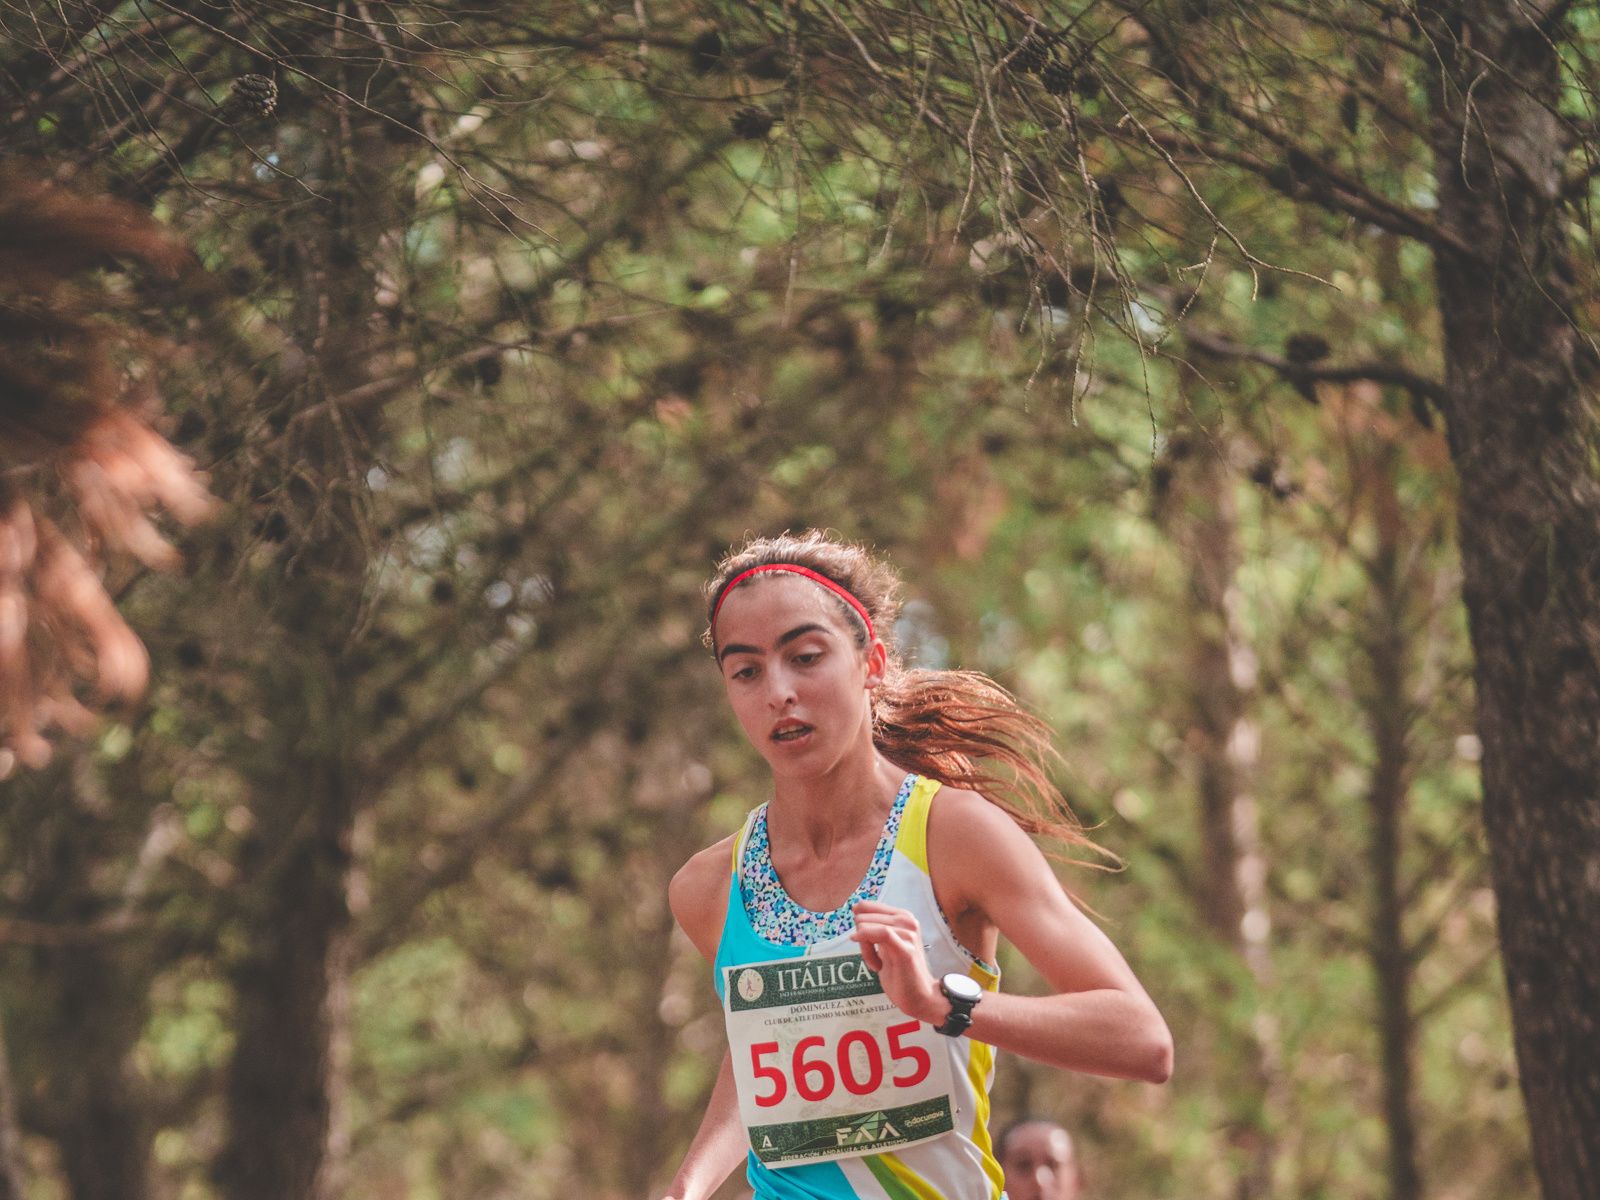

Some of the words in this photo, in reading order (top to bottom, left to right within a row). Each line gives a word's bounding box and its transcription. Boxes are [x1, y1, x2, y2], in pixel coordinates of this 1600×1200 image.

[778, 960, 874, 991] ITÁLICA
[846, 998, 865, 1008] ANA
[764, 1016, 783, 1026] CLUB
[794, 1011, 833, 1023] ATLETISMO
[834, 1008, 858, 1018] MAURI
[750, 1020, 931, 1107] 5605
[781, 1150, 819, 1162] FEDERACIÓN
[822, 1146, 858, 1156] ANDALUZA
[871, 1138, 908, 1149] ATLETISMO
